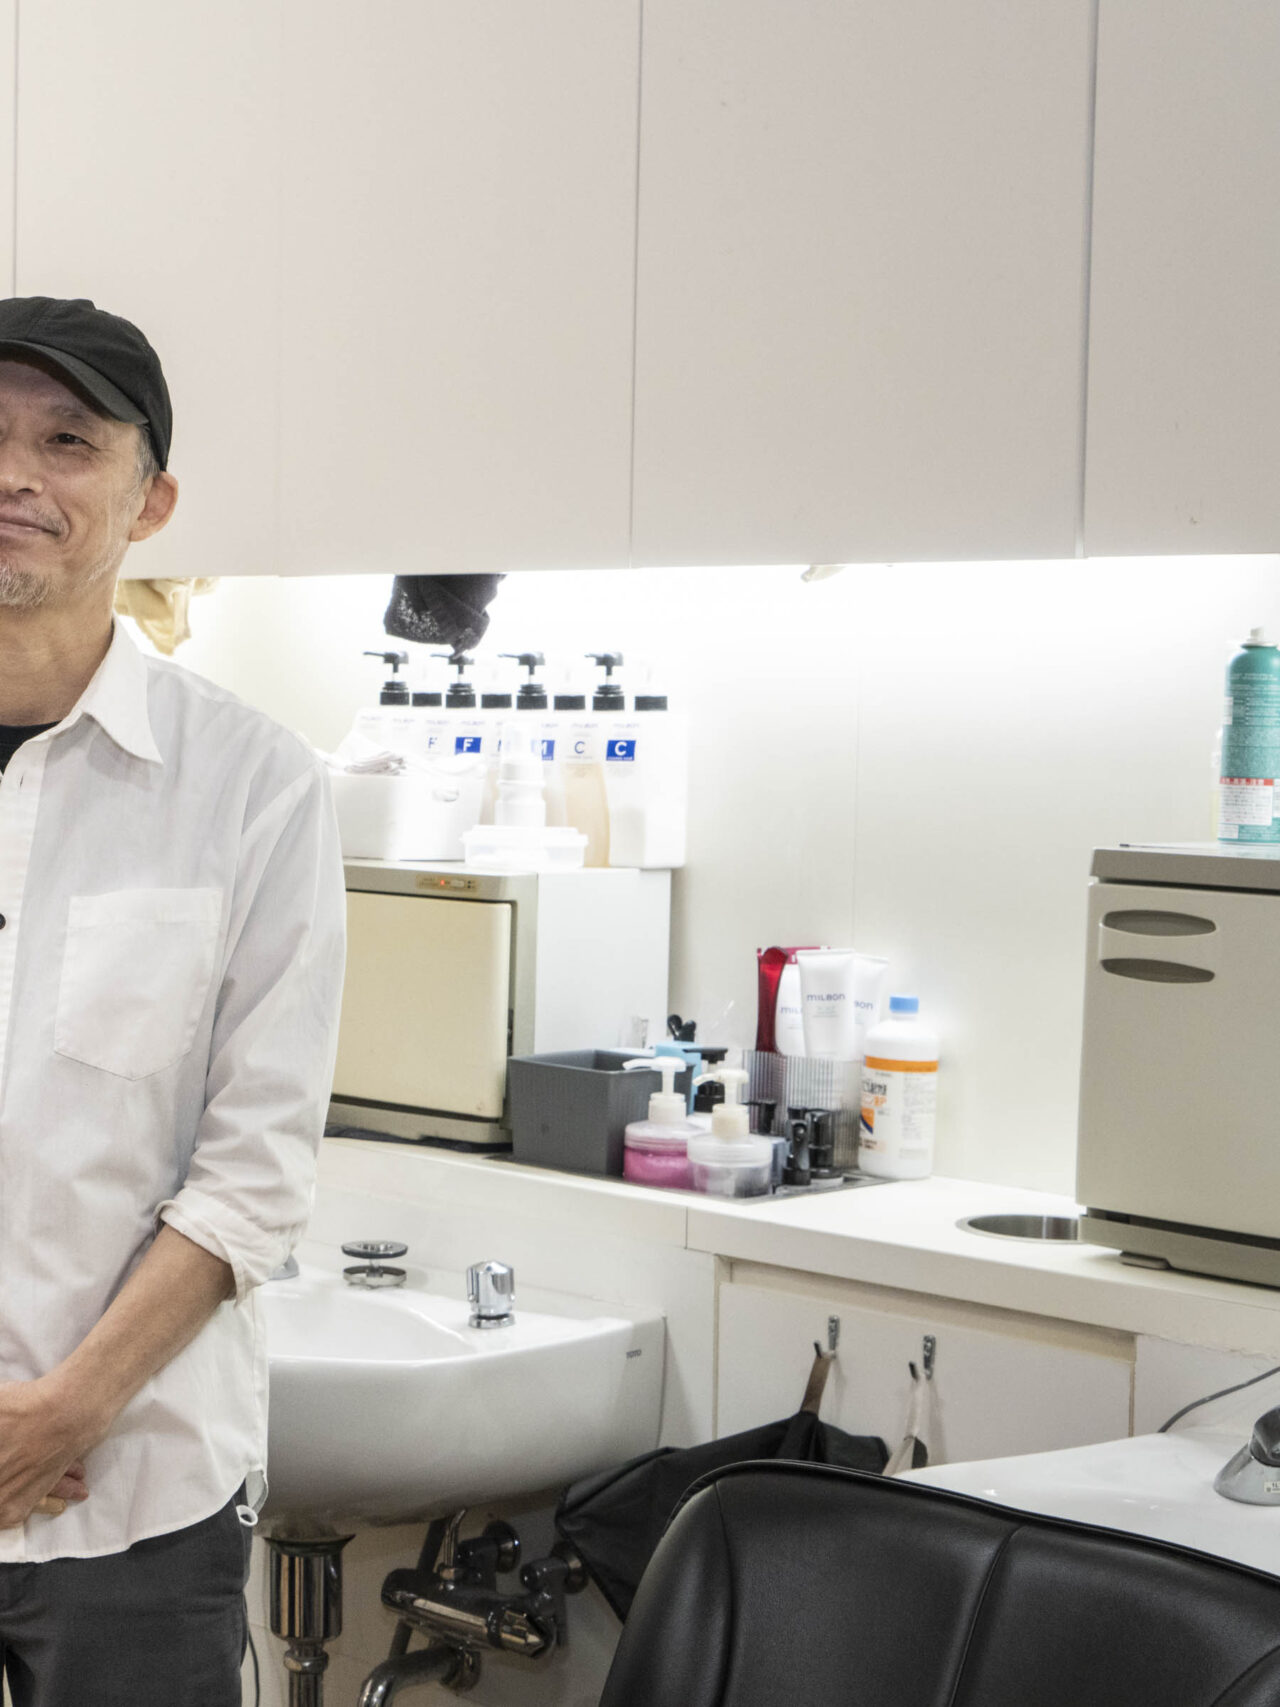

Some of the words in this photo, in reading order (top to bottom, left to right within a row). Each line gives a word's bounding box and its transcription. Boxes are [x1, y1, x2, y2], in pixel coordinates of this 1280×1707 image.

[428, 737, 438, 749] F
[463, 738, 473, 752] F
[574, 740, 586, 755] C
[614, 740, 627, 756] C
